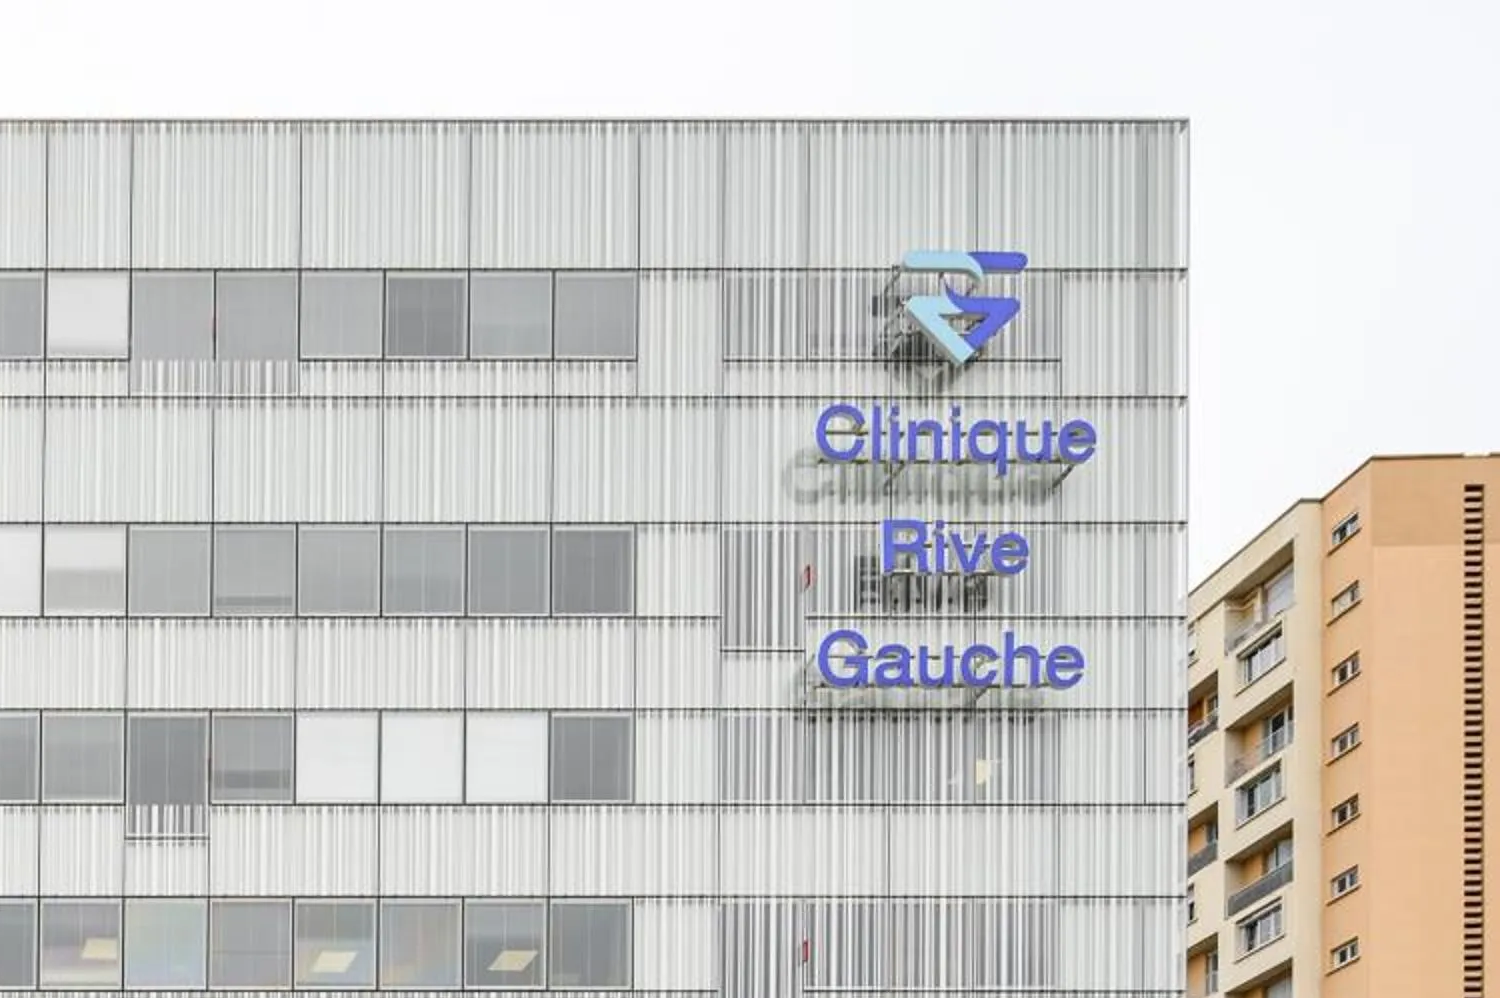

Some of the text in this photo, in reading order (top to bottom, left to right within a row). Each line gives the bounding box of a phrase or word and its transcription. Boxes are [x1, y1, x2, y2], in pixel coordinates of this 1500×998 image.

[815, 403, 1097, 476] Clinique
[881, 518, 1030, 575] Rive
[816, 629, 1088, 688] Gauche
